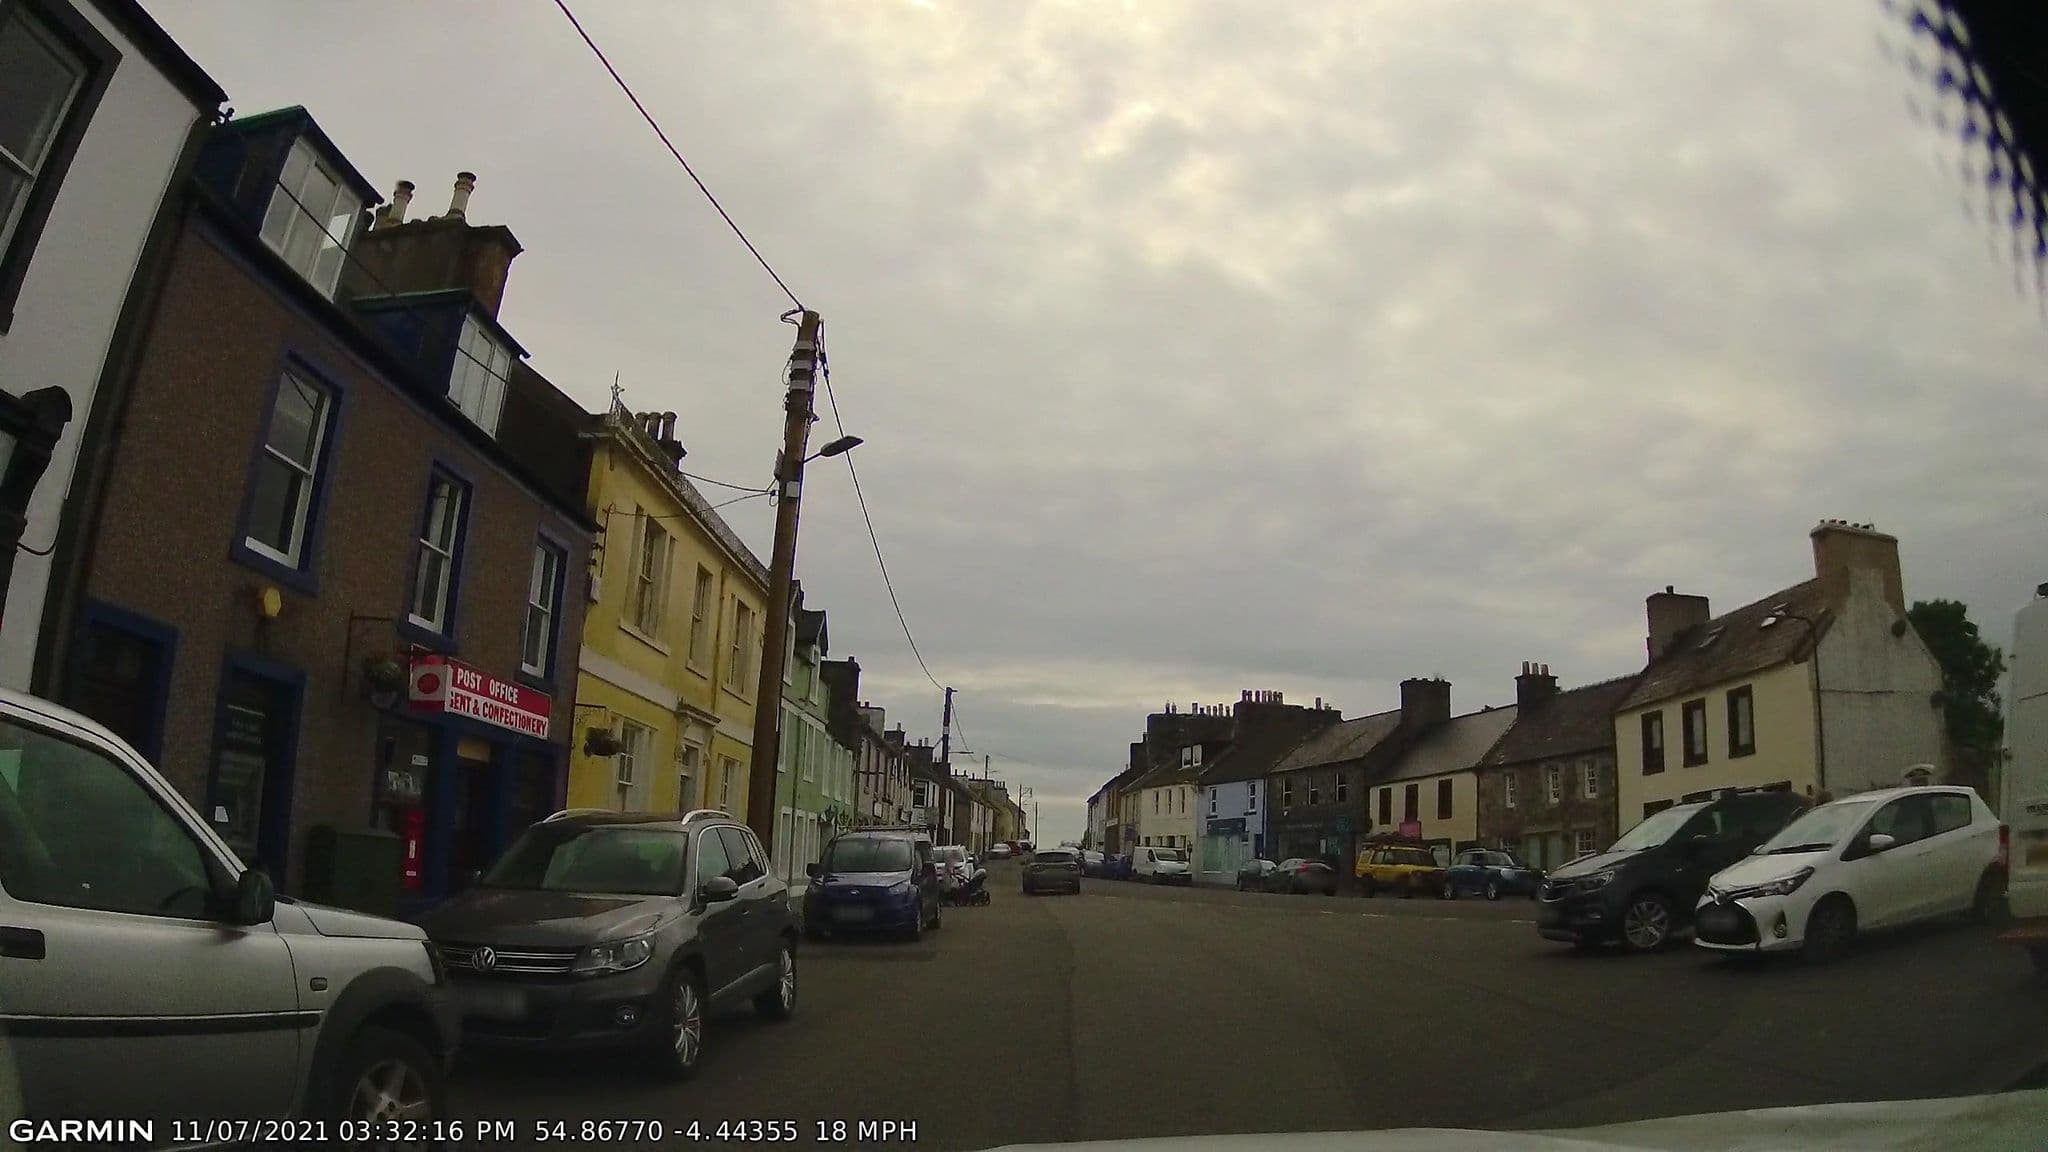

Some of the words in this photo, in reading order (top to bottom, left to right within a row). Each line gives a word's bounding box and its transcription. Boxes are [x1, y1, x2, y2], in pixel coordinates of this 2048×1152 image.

[457, 668, 482, 691] POST
[489, 679, 519, 704] OFFICE
[472, 699, 480, 716] &
[482, 702, 547, 736] CONFECTIONERY
